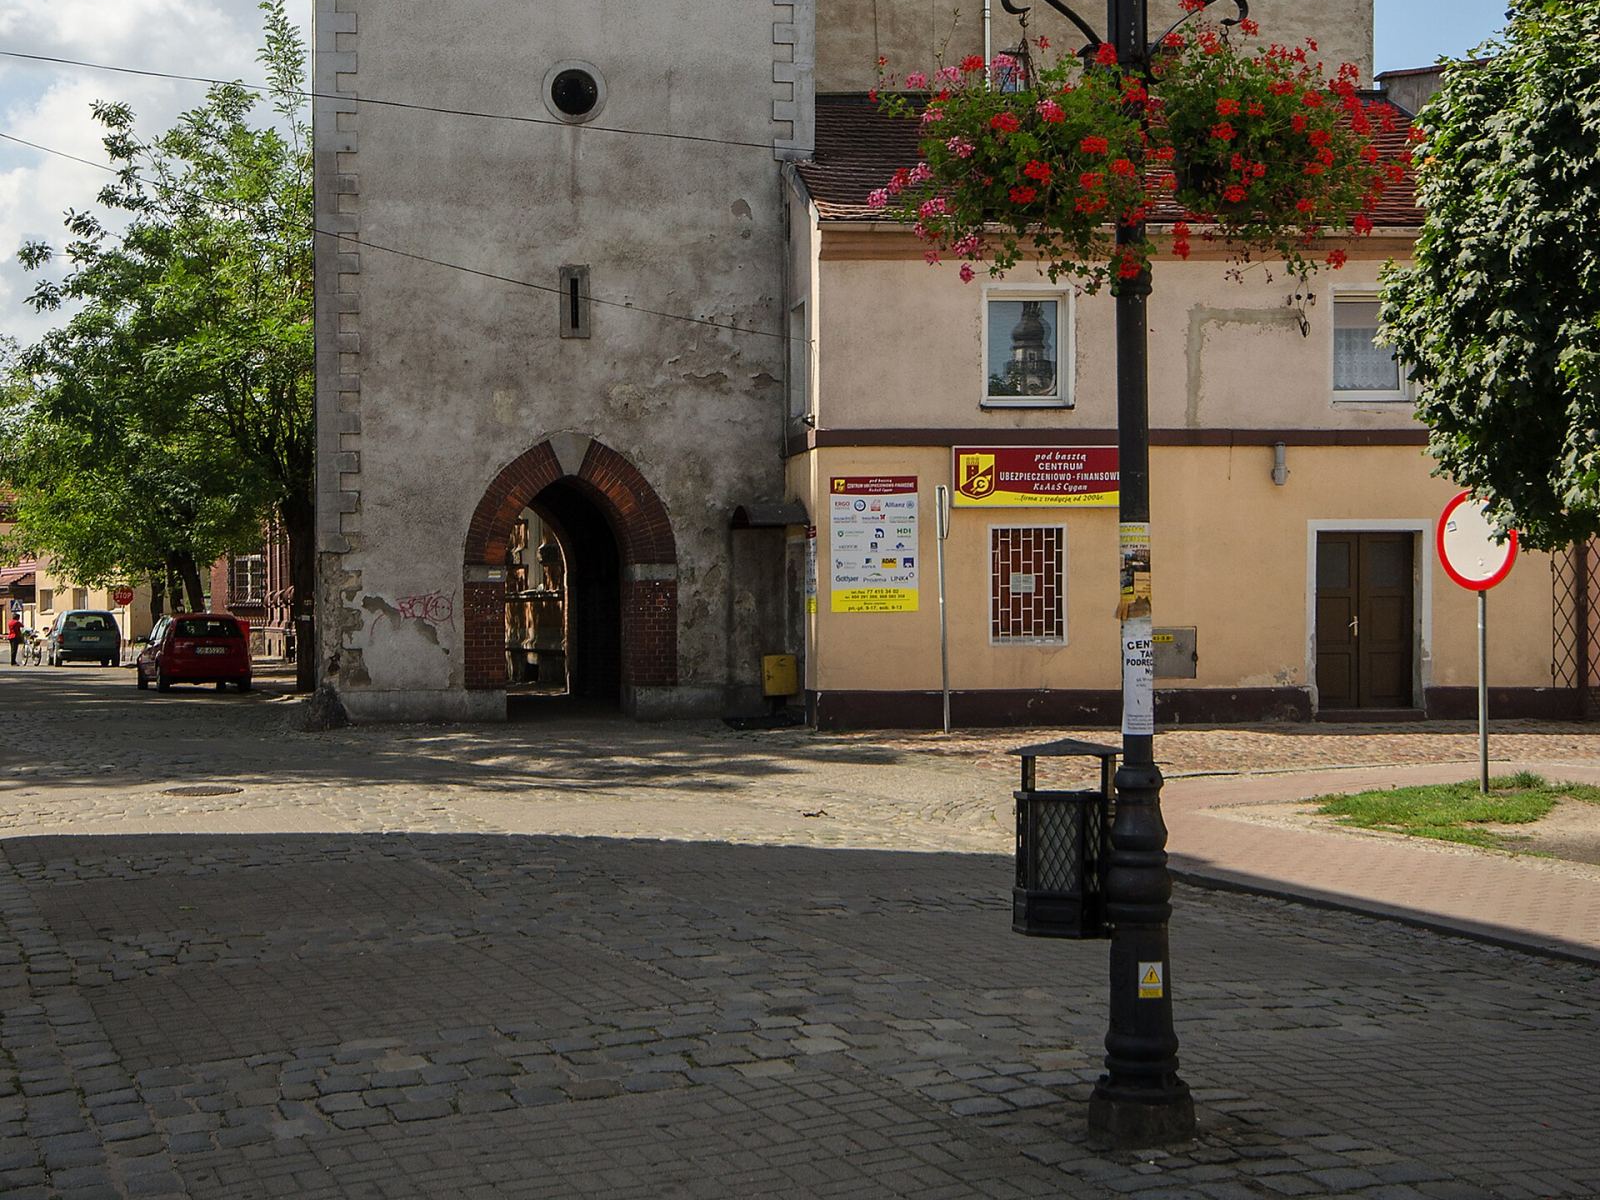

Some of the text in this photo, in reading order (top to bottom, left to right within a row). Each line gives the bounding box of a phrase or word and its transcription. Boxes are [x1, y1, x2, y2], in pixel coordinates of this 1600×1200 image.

[1034, 452, 1087, 462] pod basztą
[1038, 462, 1083, 471] CENTRUM
[1063, 483, 1088, 492] Cygan
[1044, 494, 1072, 503] tradycją
[1072, 494, 1082, 502] od
[115, 591, 132, 599] STOP
